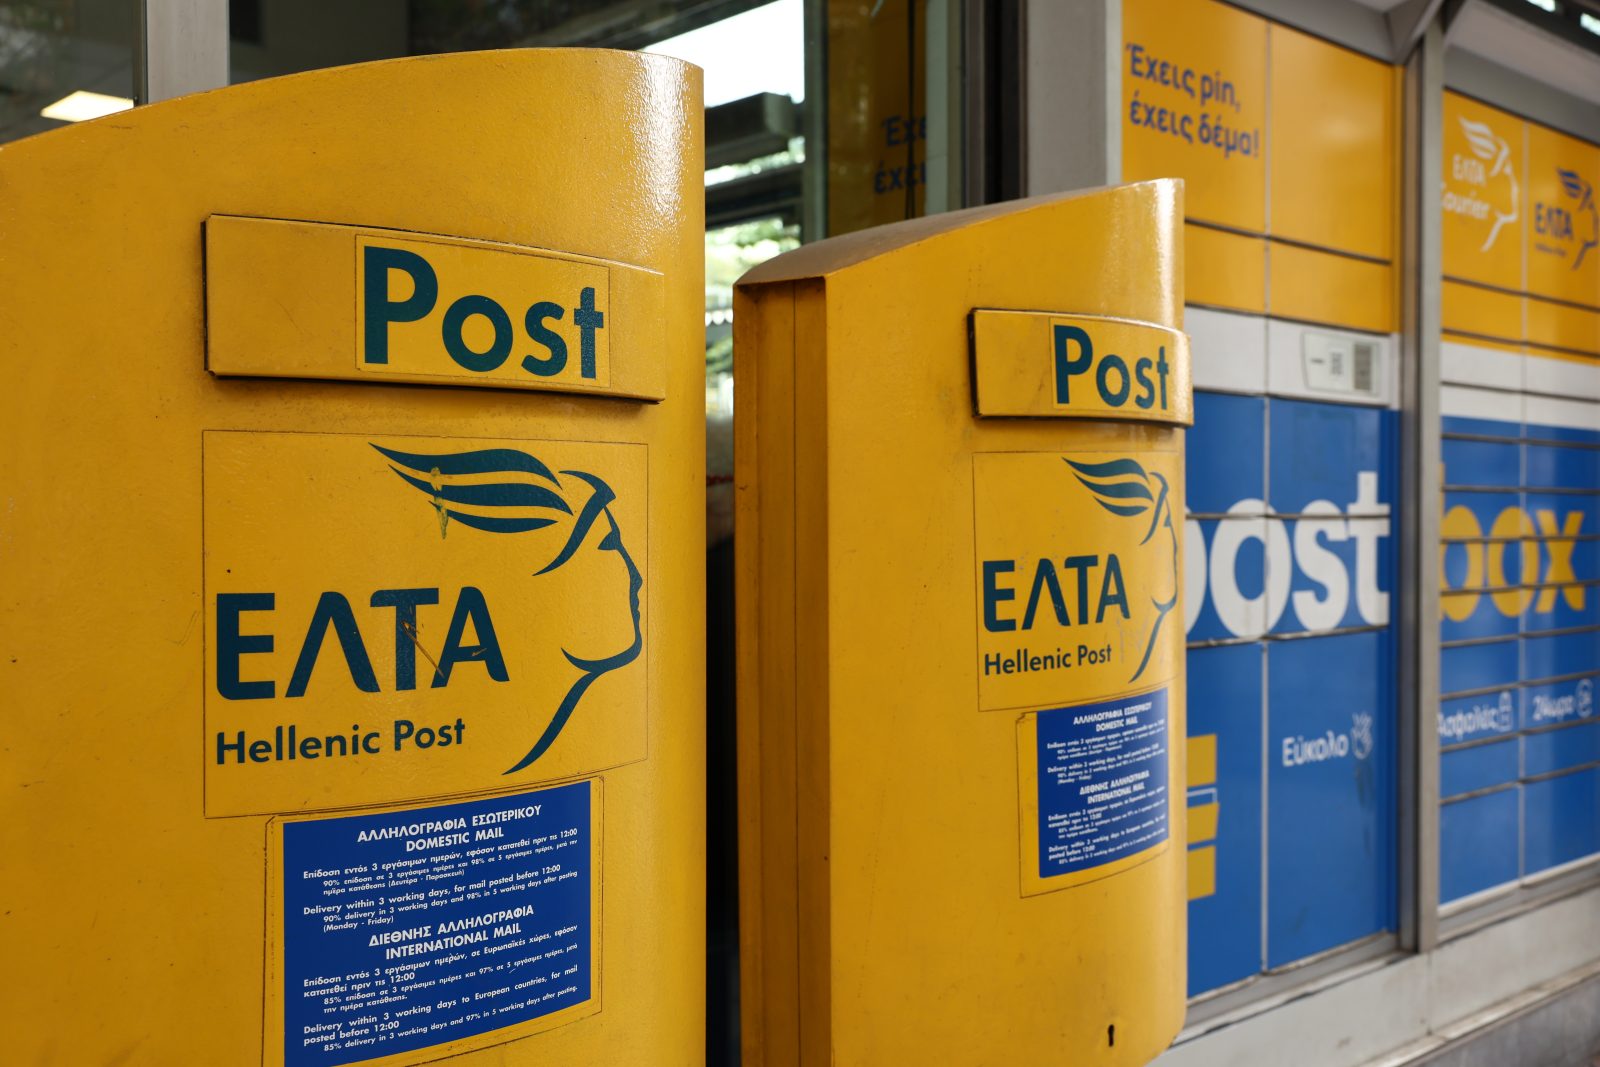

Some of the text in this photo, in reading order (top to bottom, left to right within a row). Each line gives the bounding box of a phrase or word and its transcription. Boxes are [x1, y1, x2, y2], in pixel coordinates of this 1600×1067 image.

[1126, 43, 1241, 113] Έχεις pin,
[1130, 89, 1259, 159] έχεις δέμα!
[364, 246, 603, 379] Post
[1053, 325, 1169, 410] Post
[982, 553, 1130, 633] ΕΛΤΑ
[216, 586, 510, 701] ΕΛΤΑ
[984, 644, 1112, 676] Hellenic Post
[216, 718, 466, 765] Hellenic Post
[1282, 729, 1349, 767] Εύκολο
[357, 805, 541, 842] ΑΛΛΗΛΟΓΡΑΦΙΑ ΕΣΩΤΕΡΙΚΟΥ
[406, 827, 504, 852] DOMESTIC MAIL
[303, 869, 340, 879] Επίδοση
[344, 865, 368, 874] εντός
[372, 863, 378, 871] 3
[382, 858, 427, 873] εργάσιμων
[430, 852, 463, 864] ημερών,
[466, 847, 495, 858] εφόσον
[497, 839, 530, 851] κατατεθεί
[533, 837, 547, 846] πριν
[560, 828, 577, 839] 12:00
[303, 864, 560, 915] Delivery within 3 working days, for mail posted before 12:00
[344, 910, 375, 920] delivery
[398, 902, 428, 912] working
[431, 898, 448, 907] days
[451, 895, 464, 903] and
[500, 883, 525, 893] working
[528, 878, 541, 888] days
[543, 876, 557, 884] after
[559, 871, 577, 881] posting
[323, 920, 358, 933] (Monday
[367, 916, 394, 926] Friday)
[368, 905, 534, 946] ΔΙΕΘΝΗΣ ΑΛΛΗΛΟΓΡΑΦΙΑ
[386, 923, 521, 959] INTERNATIONAL MAIL
[303, 976, 341, 987] Επίδοση
[346, 970, 370, 980] εντός
[374, 968, 380, 976] 3
[385, 961, 430, 975] εργάσιμων
[434, 952, 467, 966] ημερών,
[484, 940, 525, 954] Ευρωπαϊκές
[529, 934, 551, 944] χώρες,
[554, 925, 578, 936] εφόσον
[303, 1023, 343, 1034] Delivery
[349, 1016, 377, 1026] within
[395, 1005, 431, 1018] working
[437, 1001, 456, 1009] days
[474, 987, 510, 1000] European
[514, 977, 547, 990] countries,
[551, 972, 560, 980] for
[564, 965, 578, 976] mail
[304, 985, 347, 997] κατατεθεί
[352, 982, 371, 992] πριν
[390, 972, 415, 983] 12:00
[340, 1002, 363, 1012] ημέρα
[367, 995, 408, 1006] κατάθεσης.
[304, 1020, 399, 1046] posted before 12:00
[324, 1043, 341, 1051] 85%
[345, 1037, 376, 1048] delivery
[398, 1026, 428, 1037] working
[431, 1022, 448, 1031] days
[450, 1017, 463, 1026] and
[465, 1013, 480, 1021] 97%
[499, 1003, 524, 1013] working
[527, 997, 540, 1006] days
[542, 993, 555, 1001] after
[557, 985, 578, 997] posting.
